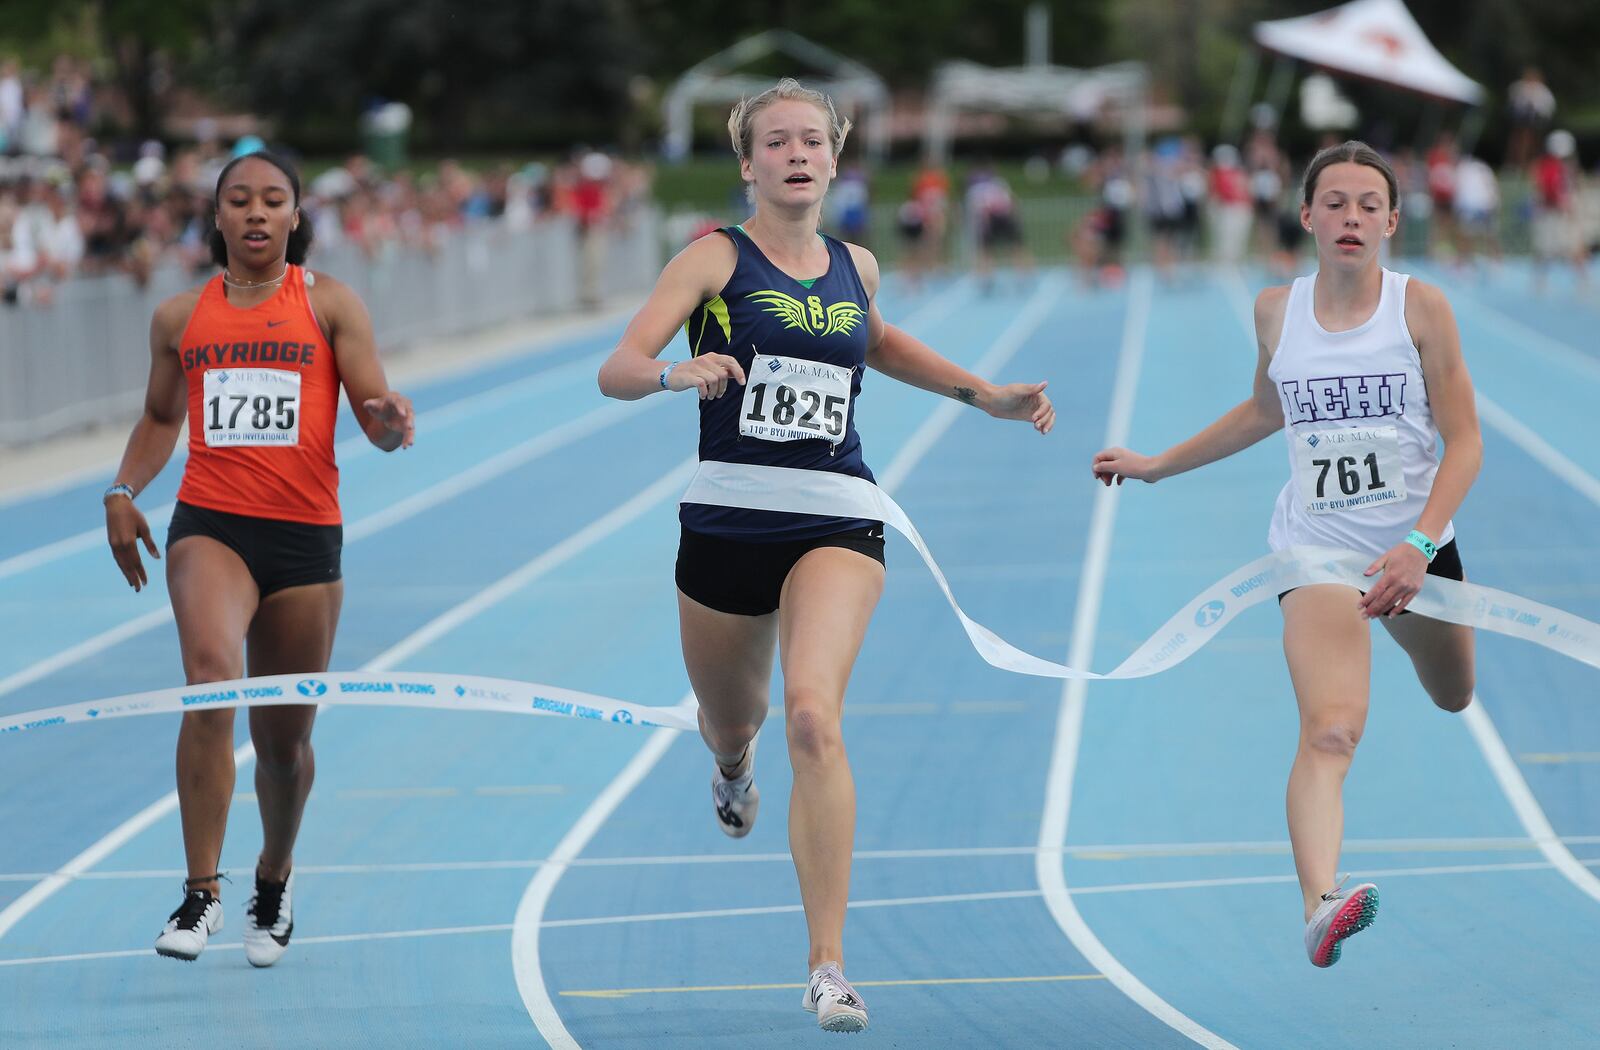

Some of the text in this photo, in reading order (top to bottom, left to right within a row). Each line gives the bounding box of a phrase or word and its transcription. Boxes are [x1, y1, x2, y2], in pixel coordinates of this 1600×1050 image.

[184, 341, 316, 370] SKYRIDGE
[811, 367, 840, 381] MAC
[208, 395, 296, 430] 1785
[746, 382, 846, 436] 1825
[1281, 373, 1407, 426] LEHI
[228, 433, 241, 441] BYU
[242, 433, 289, 441] INVITATIONAL
[770, 427, 786, 437] BYU
[787, 429, 834, 442] INVITATIO
[1351, 431, 1381, 441] MAC
[1312, 452, 1386, 498] 761
[1330, 500, 1345, 509] BYU
[1346, 489, 1398, 507] INVITATIONAL
[182, 690, 239, 705] BRIGHAM
[241, 686, 283, 698] YOUNG
[340, 681, 394, 693] BRIGHAM
[396, 682, 436, 694] YOUNG
[532, 696, 573, 715] BRIGHAM
